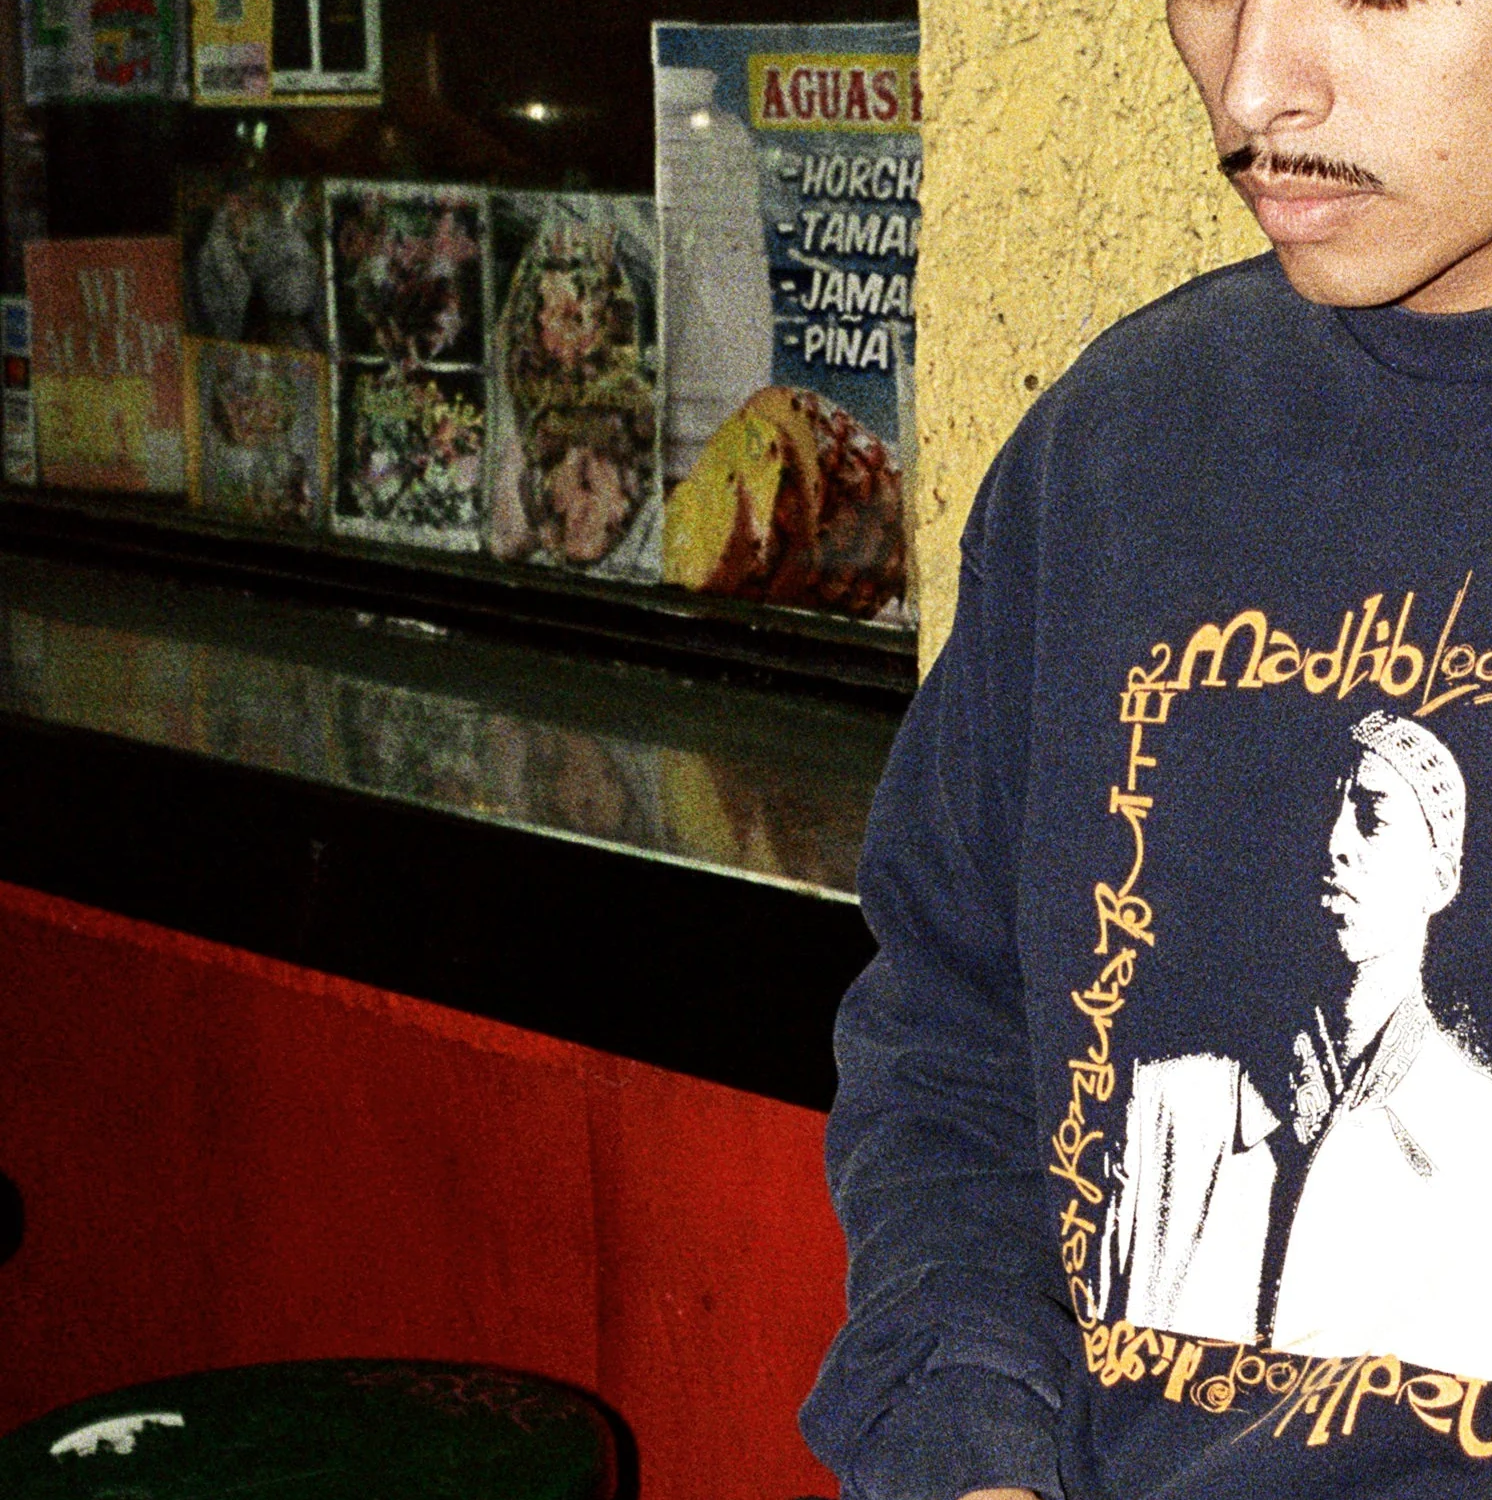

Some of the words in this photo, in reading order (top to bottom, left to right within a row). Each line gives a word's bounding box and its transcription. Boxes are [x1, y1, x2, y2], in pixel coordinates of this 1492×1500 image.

[762, 68, 898, 122] AGUAS
[800, 270, 915, 317] JAMA
[804, 313, 889, 370] PIÑA
